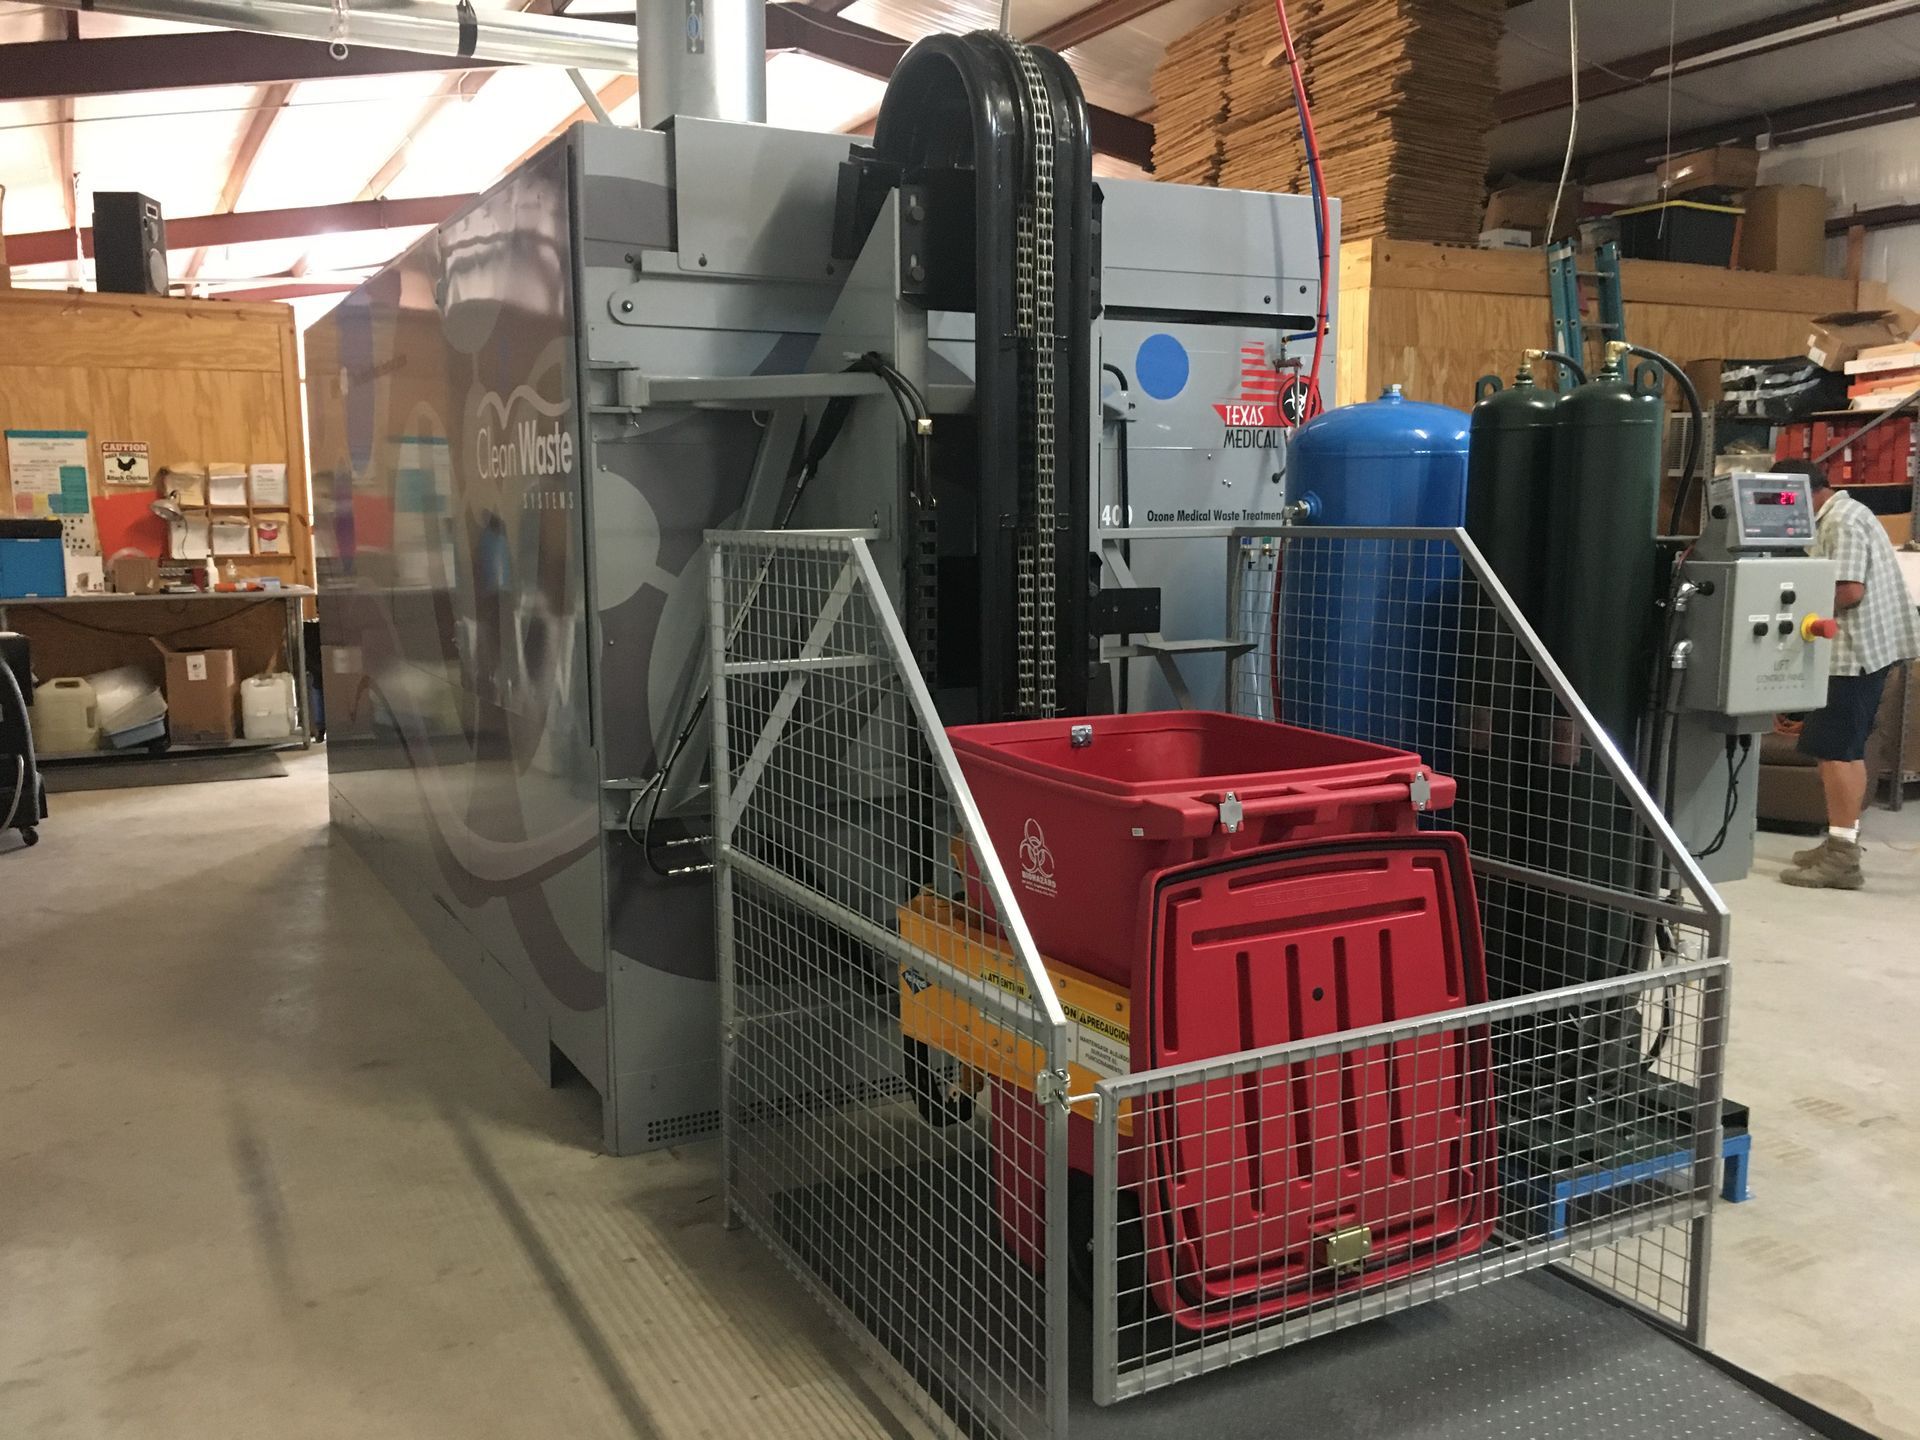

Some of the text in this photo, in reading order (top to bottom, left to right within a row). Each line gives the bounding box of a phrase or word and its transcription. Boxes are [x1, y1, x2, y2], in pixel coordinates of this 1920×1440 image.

[1225, 405, 1264, 426] TEXAS
[102, 443, 147, 452] CAUTION
[1223, 429, 1279, 449] MEDICAL
[476, 419, 573, 479] Clean Waste
[523, 491, 574, 510] SYSTEMS
[1146, 509, 1175, 523] Ozone
[1176, 508, 1211, 522] Medical
[1213, 508, 1240, 522] Waste
